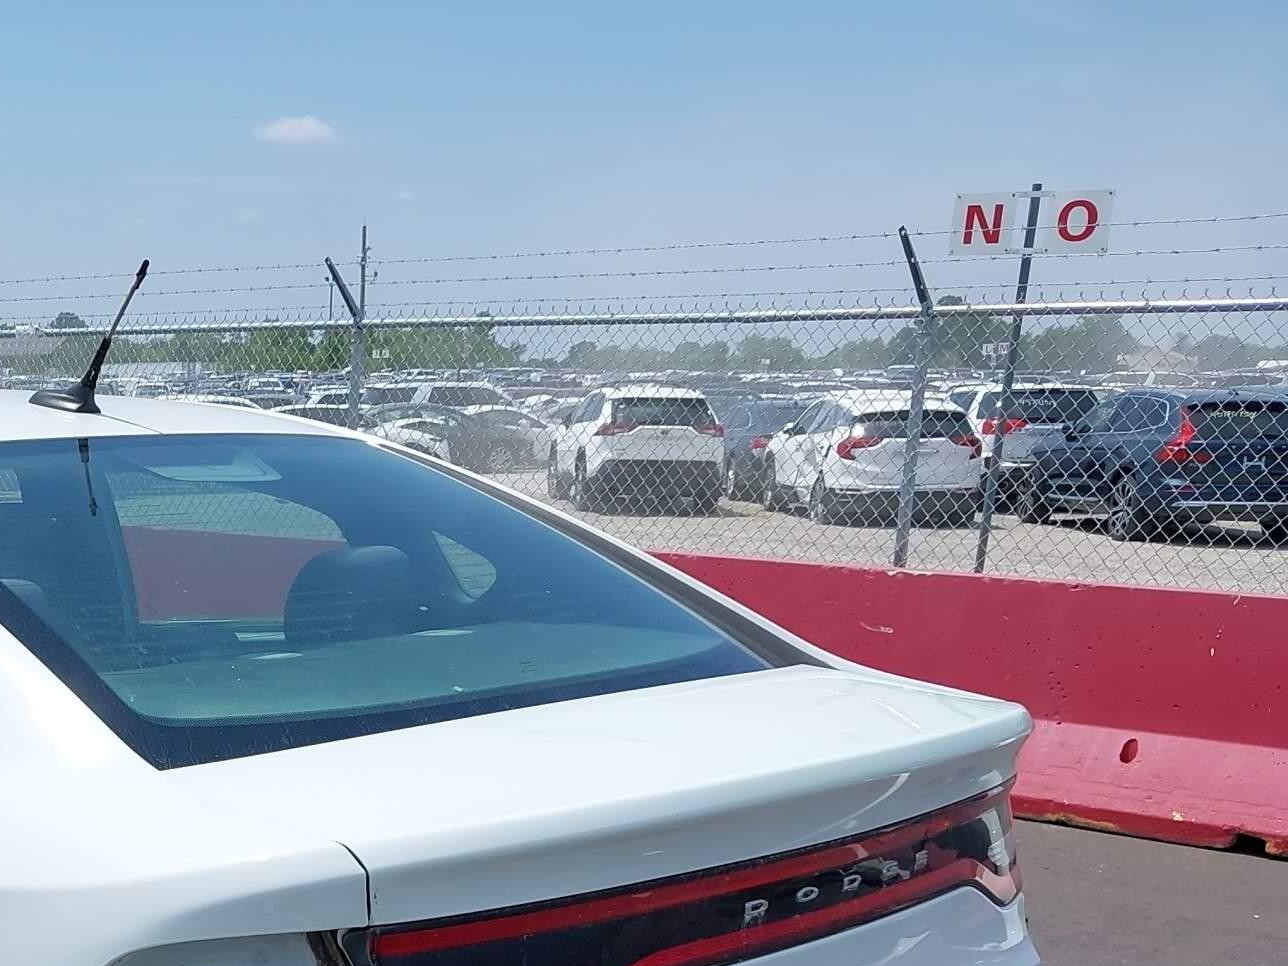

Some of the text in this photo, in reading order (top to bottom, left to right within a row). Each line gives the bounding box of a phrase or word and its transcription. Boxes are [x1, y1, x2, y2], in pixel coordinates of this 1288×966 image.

[962, 199, 1099, 245] N O
[743, 849, 929, 917] DODGE
